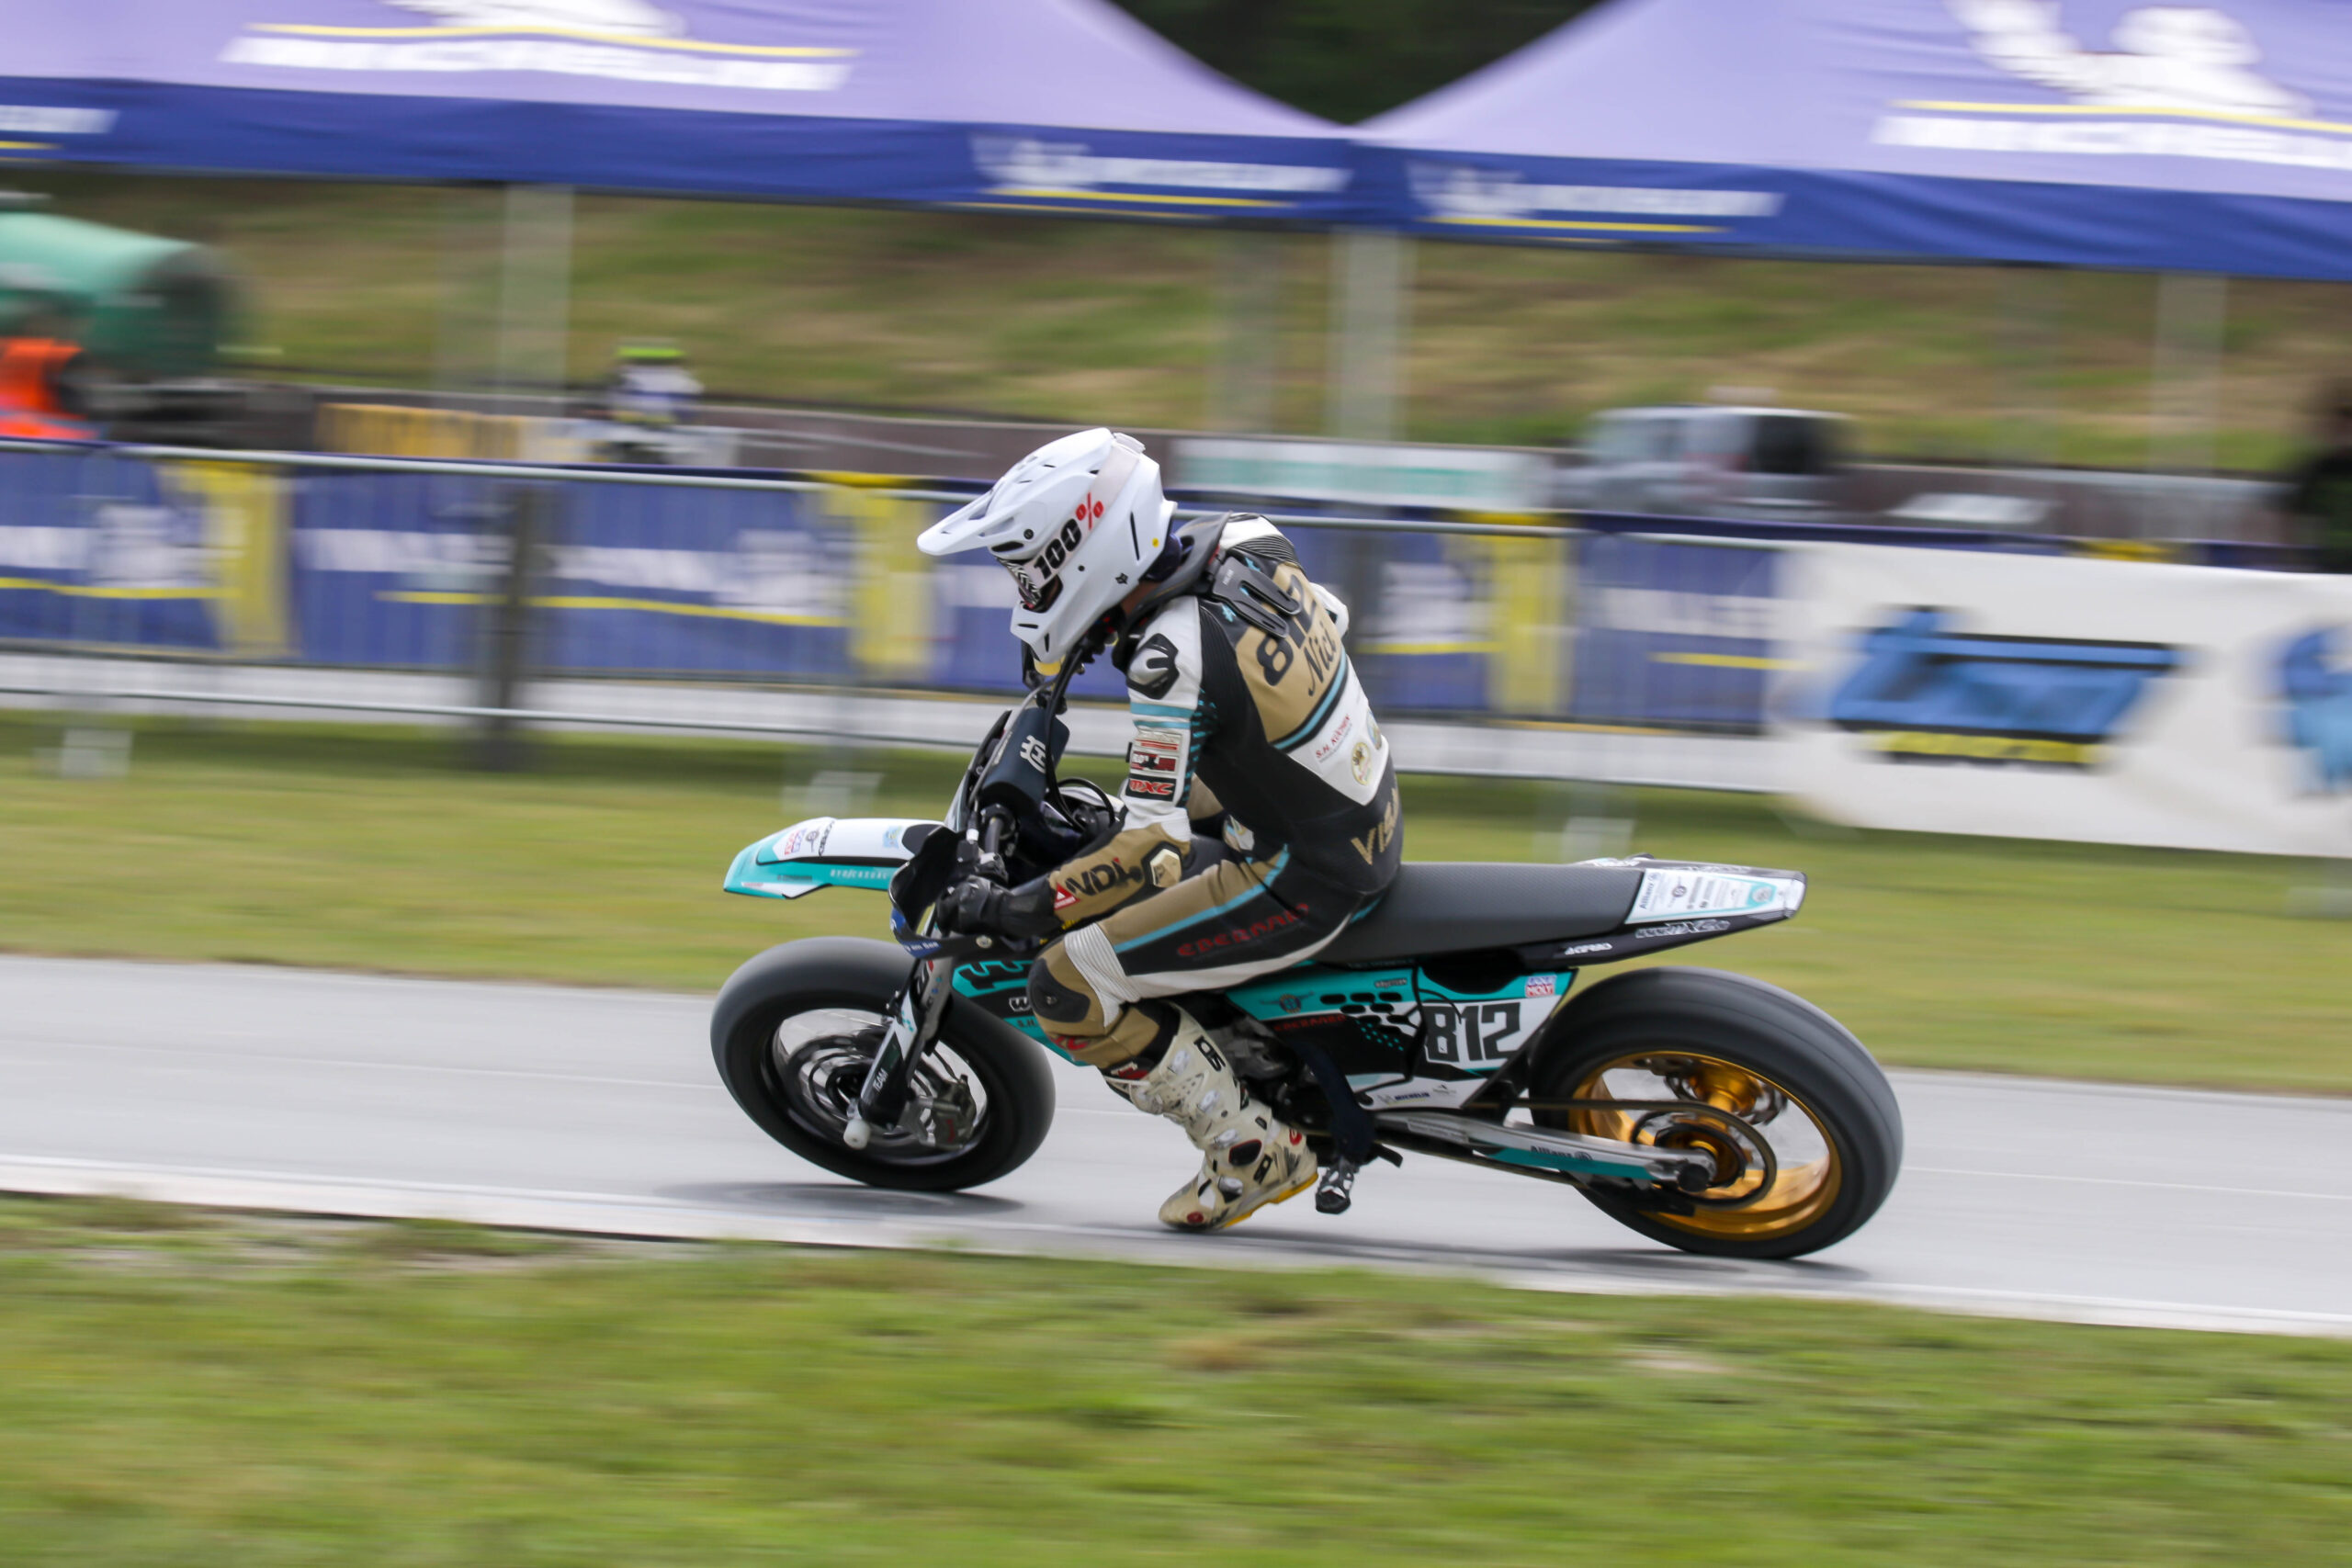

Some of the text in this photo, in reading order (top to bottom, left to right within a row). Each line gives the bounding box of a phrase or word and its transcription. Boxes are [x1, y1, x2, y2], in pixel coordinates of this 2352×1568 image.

[1034, 491, 1104, 580] 100%
[1424, 1002, 1521, 1062] 812
[873, 1068, 889, 1093] TEAM
